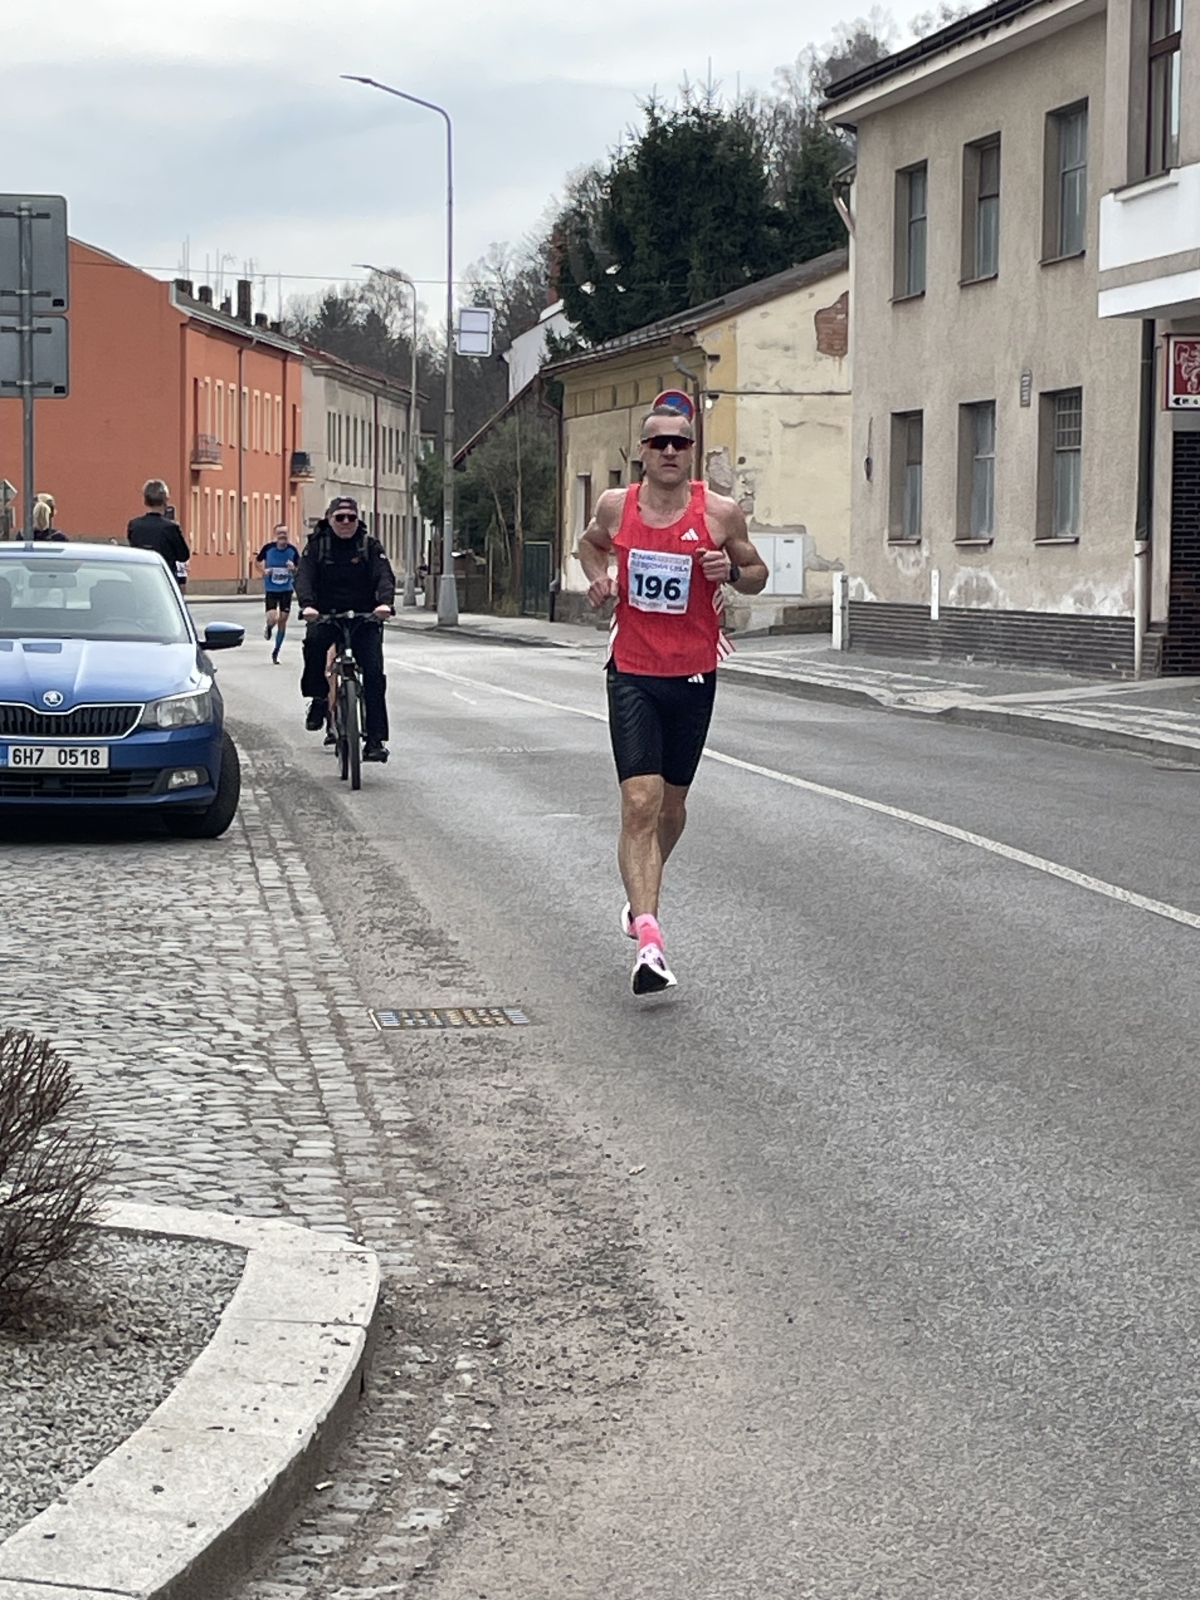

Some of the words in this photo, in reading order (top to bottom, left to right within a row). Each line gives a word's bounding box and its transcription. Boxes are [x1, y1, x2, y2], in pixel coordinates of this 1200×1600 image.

[634, 573, 682, 601] 196
[12, 747, 45, 766] 6H7
[57, 748, 100, 766] 0518
